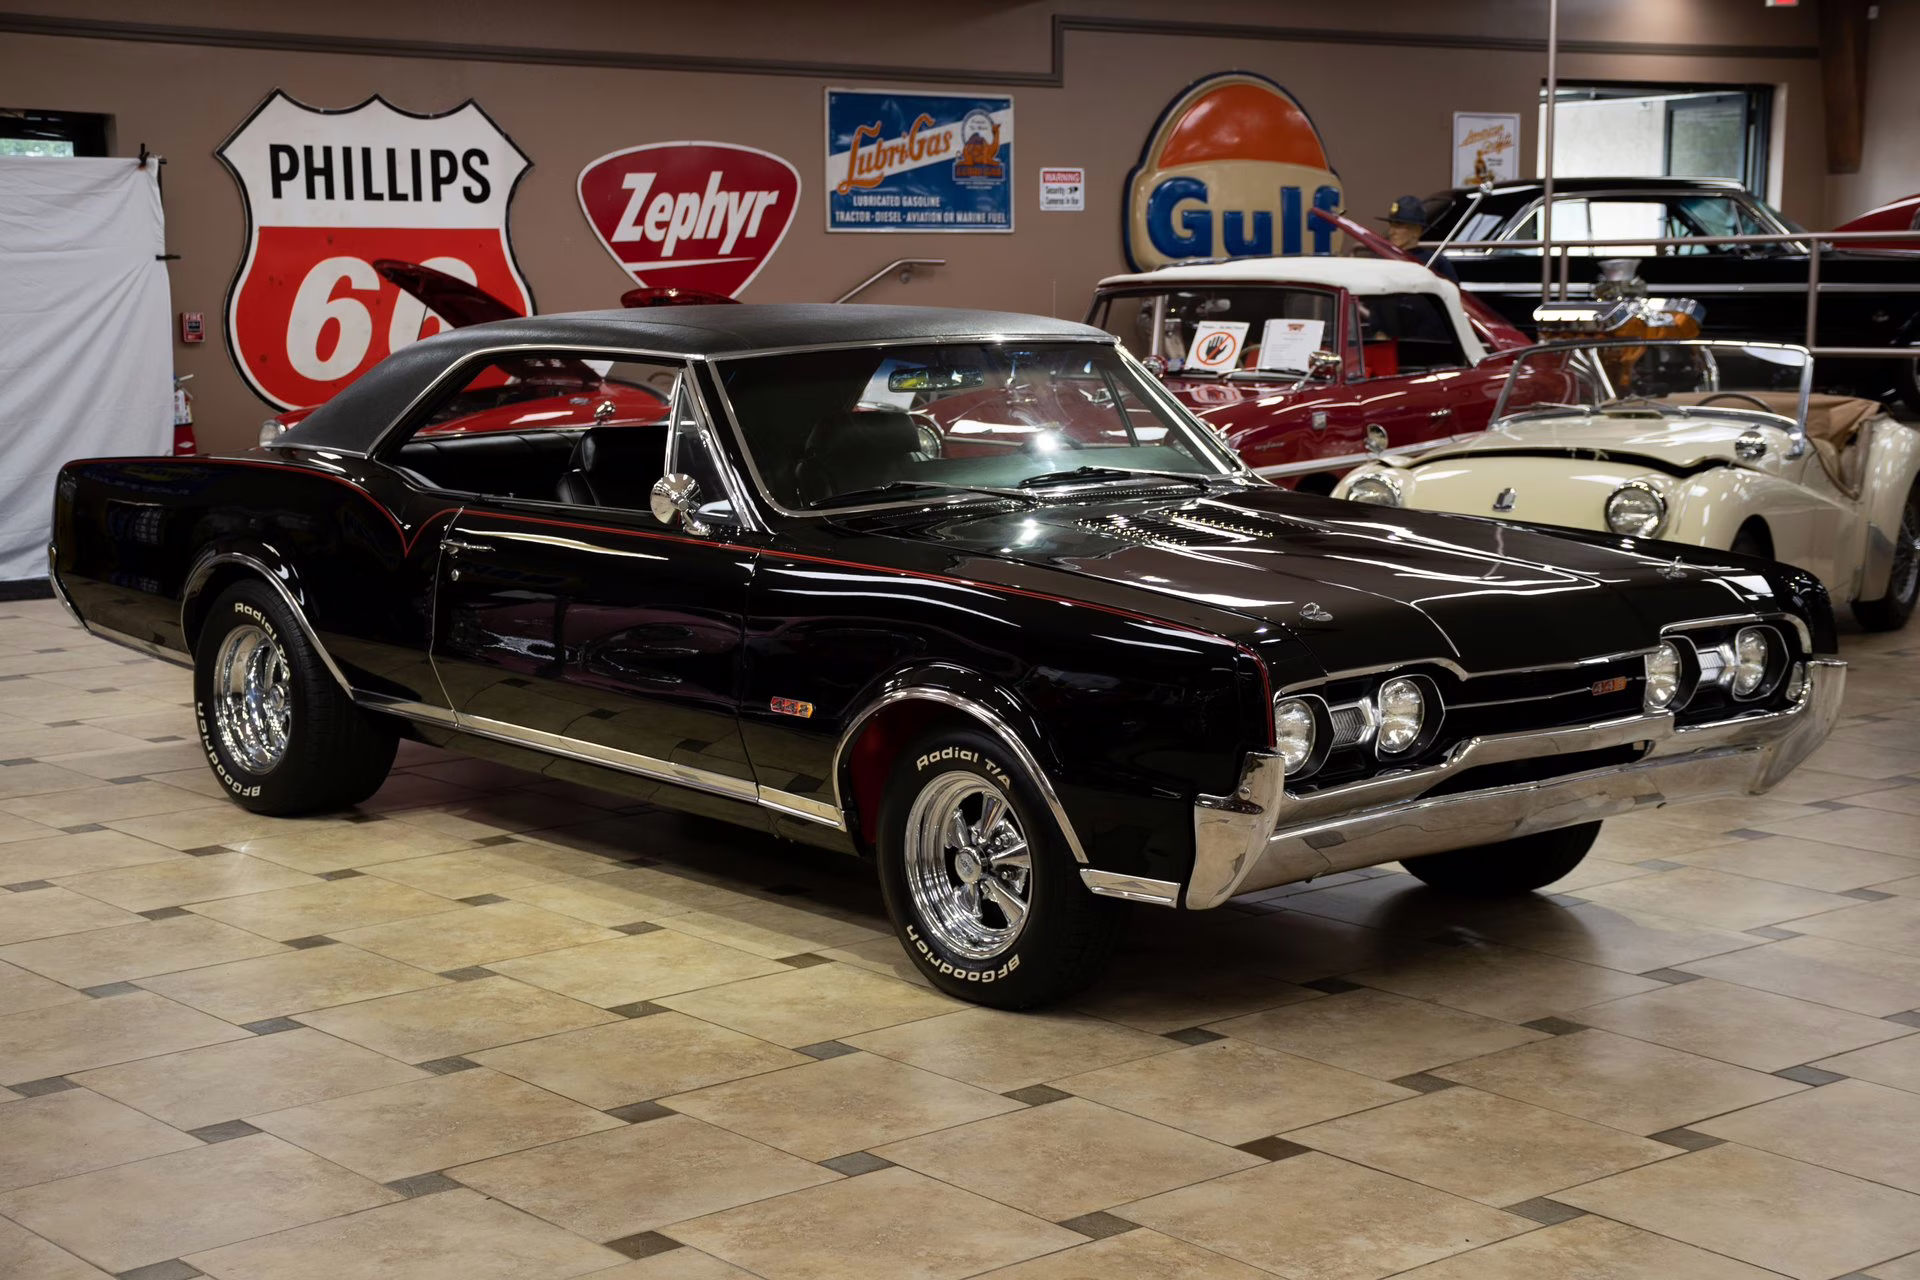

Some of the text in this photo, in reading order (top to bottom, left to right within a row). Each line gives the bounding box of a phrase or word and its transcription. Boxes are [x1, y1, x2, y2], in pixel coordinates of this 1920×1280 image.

[268, 143, 491, 204] PHILLIPS
[853, 195, 941, 207] LUBRICATED GASOLINE
[1044, 172, 1081, 183] WARNING
[610, 171, 780, 257] Zephyr
[835, 211, 1006, 224] TRACTOR DIESEL AVIATION OR MARINE FUEL
[1146, 176, 1341, 259] Gulf
[234, 602, 291, 682] Radial T/A
[198, 702, 261, 797] BFGoodrich
[916, 746, 1012, 791] Radial T/A
[905, 924, 1020, 983] BFGoodrich
